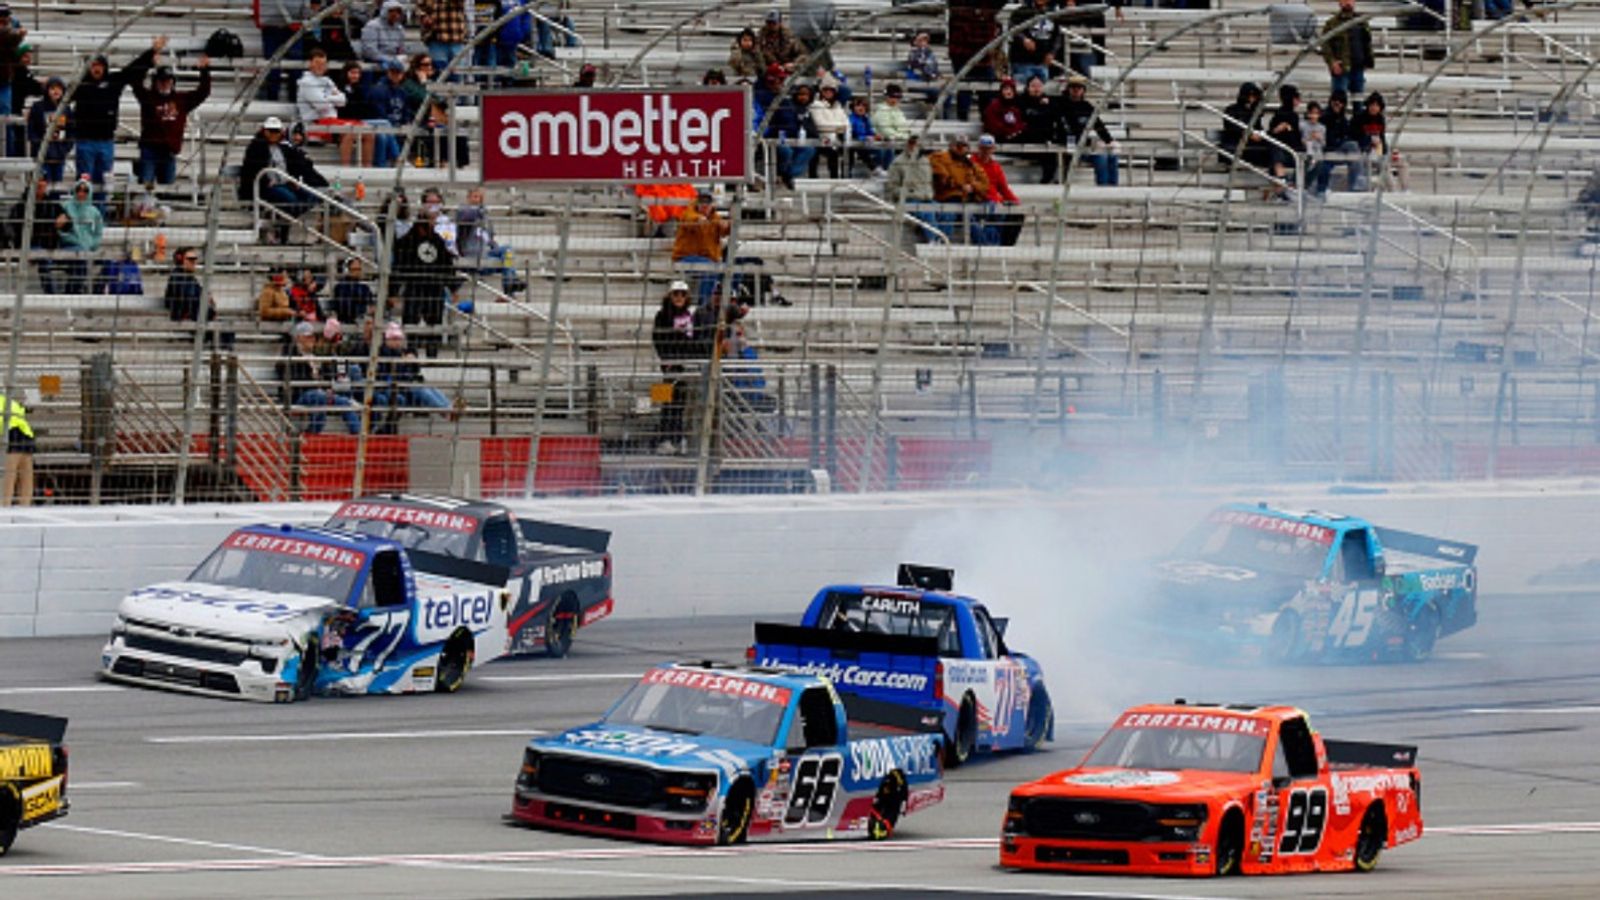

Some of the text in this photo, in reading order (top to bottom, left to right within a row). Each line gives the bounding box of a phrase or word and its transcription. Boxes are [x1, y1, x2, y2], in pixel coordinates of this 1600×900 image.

[499, 94, 731, 158] ambetter
[622, 159, 722, 178] HEALTH
[343, 503, 465, 529] CRAFTSMAN
[232, 533, 352, 566] CRAFTSMAN
[424, 590, 495, 630] telcel
[861, 596, 920, 614] CARUTH
[1328, 589, 1379, 648] 45
[350, 609, 411, 674] 77
[649, 668, 778, 700] CRAFTSMAN
[1122, 713, 1256, 733] CRAFTSMAN
[850, 738, 896, 783] SODA
[783, 752, 845, 829] 66
[1277, 785, 1330, 856] 99
